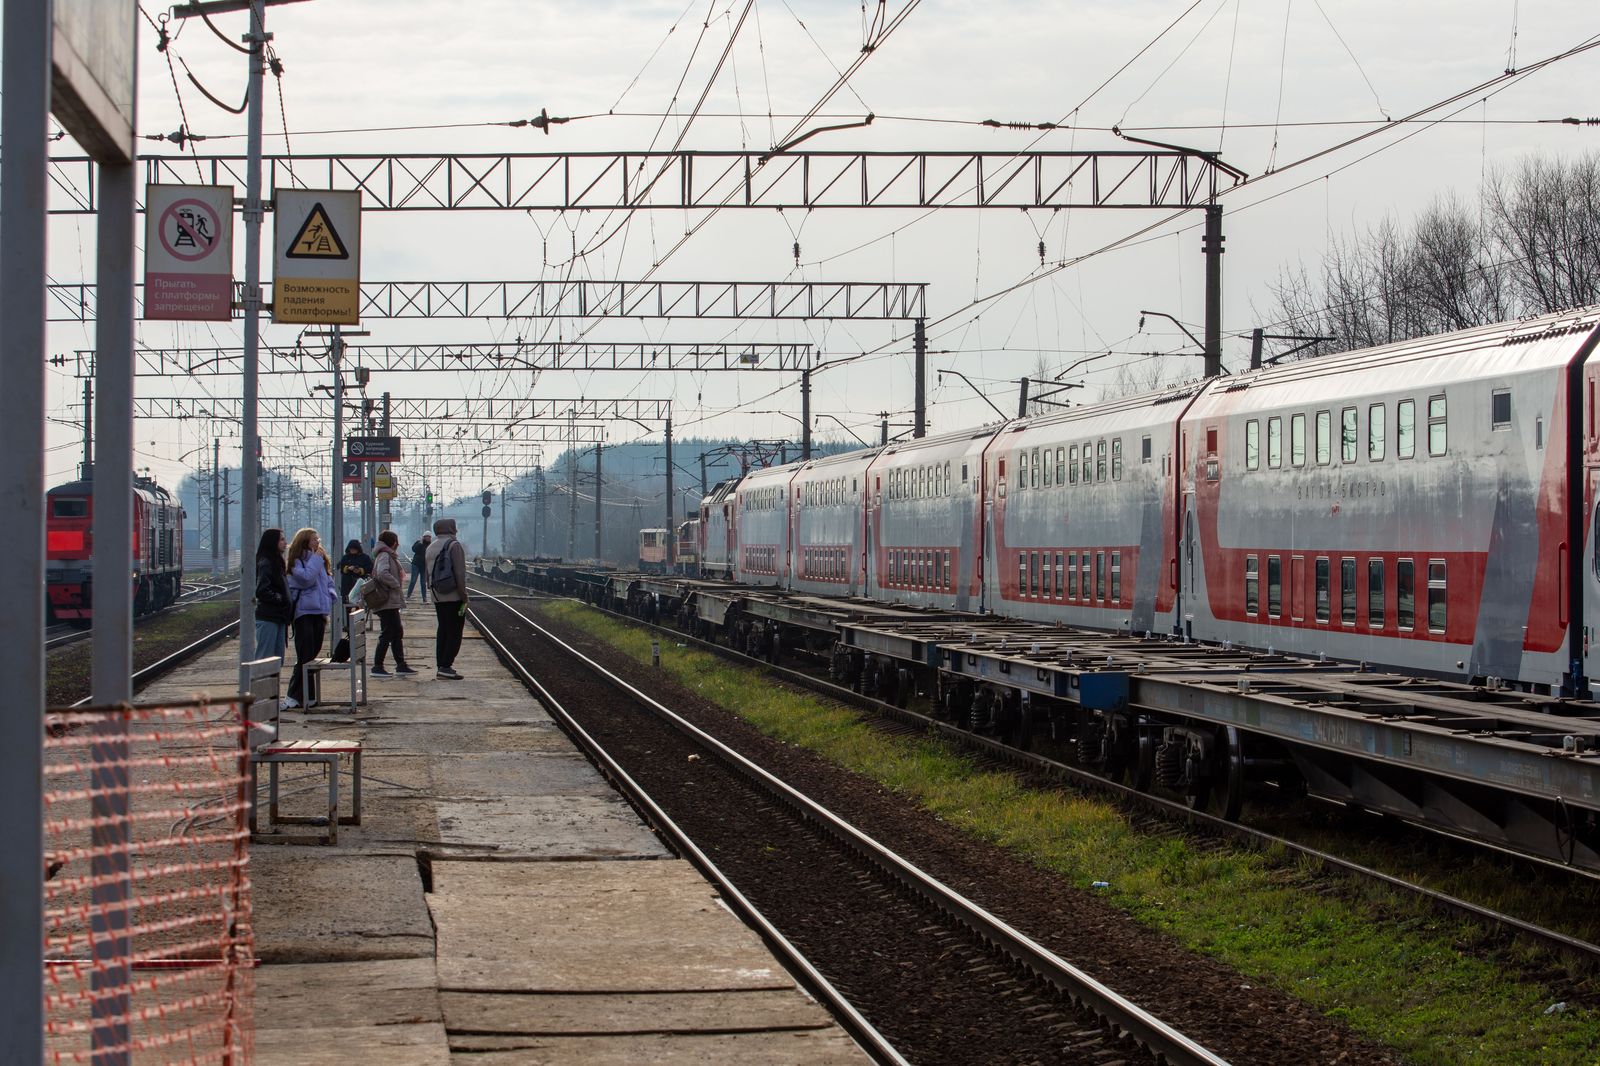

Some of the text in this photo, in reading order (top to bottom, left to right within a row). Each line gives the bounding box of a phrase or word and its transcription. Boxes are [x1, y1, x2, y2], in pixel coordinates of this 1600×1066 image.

[154, 278, 197, 289] Прыгать
[284, 283, 350, 294] Возможность
[161, 290, 220, 301] платформы
[283, 296, 325, 305] падения
[153, 303, 214, 312] запрещено!
[290, 306, 351, 317] платформы!
[349, 464, 358, 477] 2
[1297, 480, 1386, 500] ВАГОН-БИСТРО
